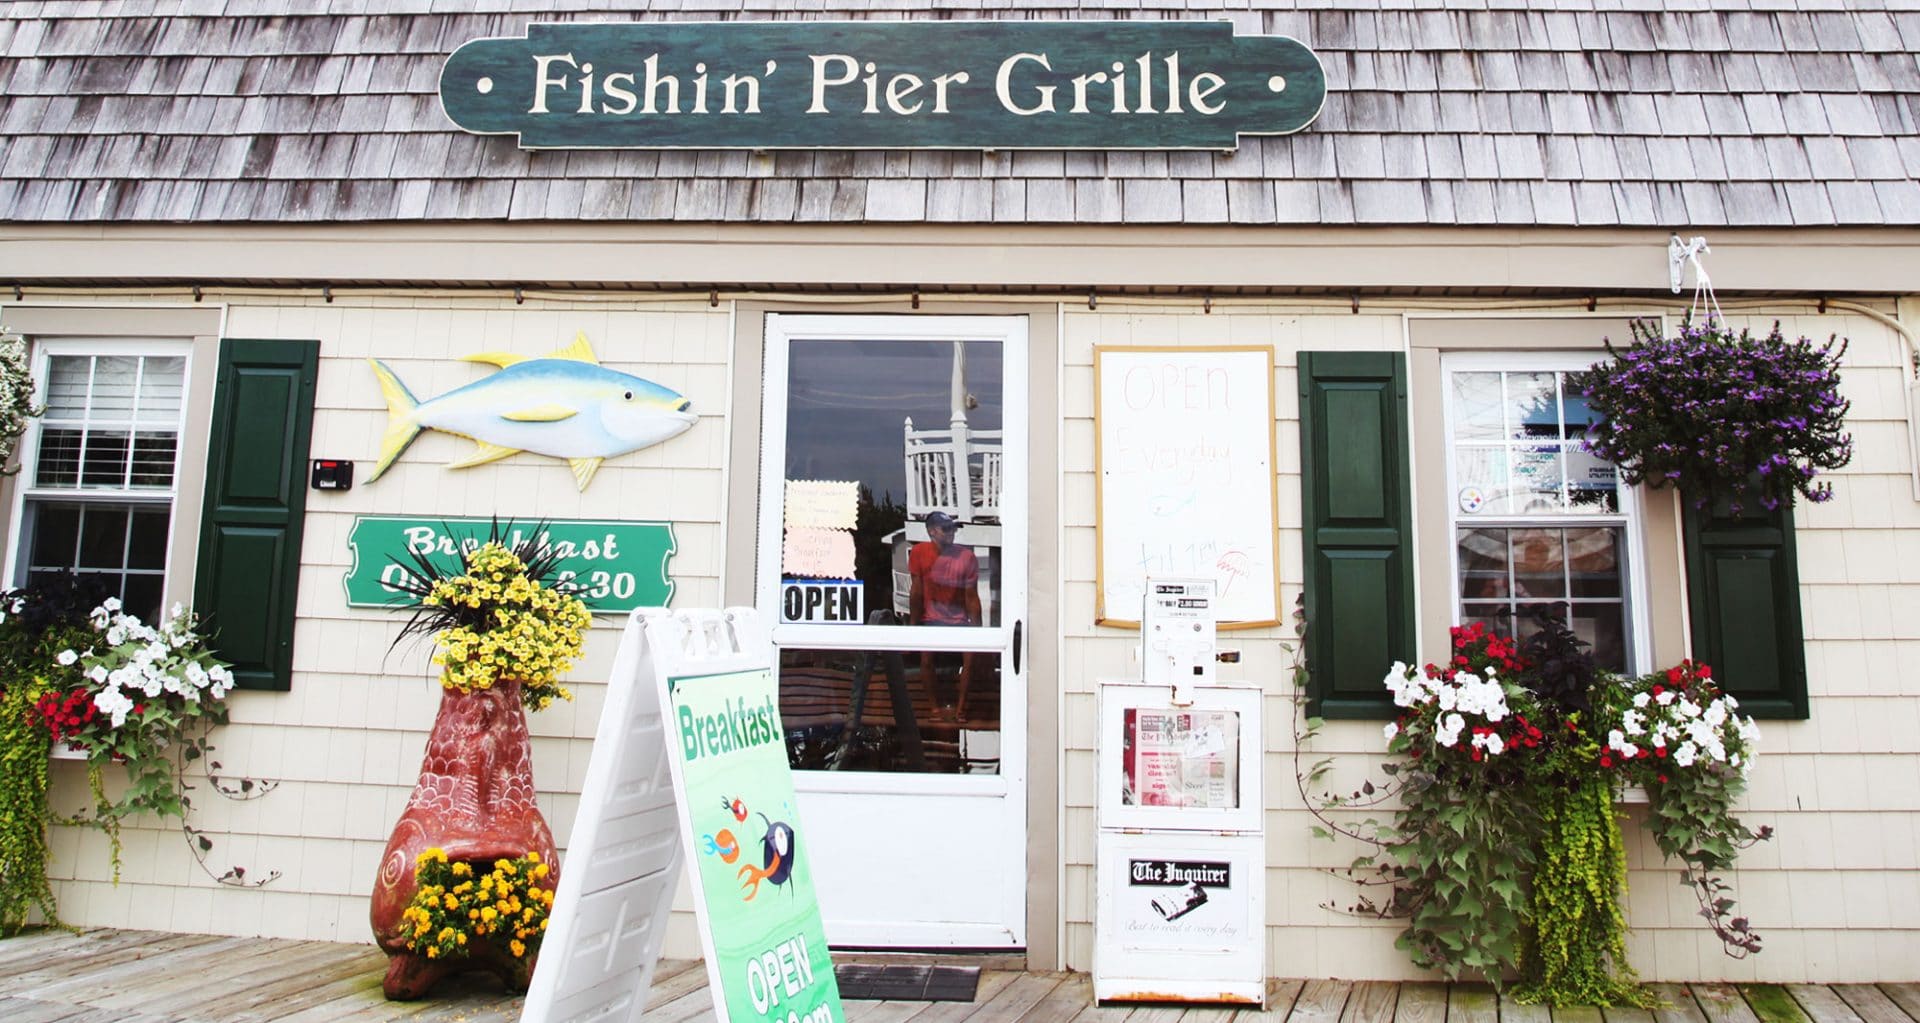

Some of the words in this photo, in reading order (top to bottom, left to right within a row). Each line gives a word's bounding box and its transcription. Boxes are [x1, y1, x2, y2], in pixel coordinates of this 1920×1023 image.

[804, 53, 970, 116] Pier
[995, 50, 1227, 116] Grille
[784, 585, 858, 621] OPEN
[678, 694, 780, 763] Breakfast
[1132, 861, 1162, 882] The
[1163, 861, 1228, 884] Inquirer
[746, 932, 815, 1017] OPEN
